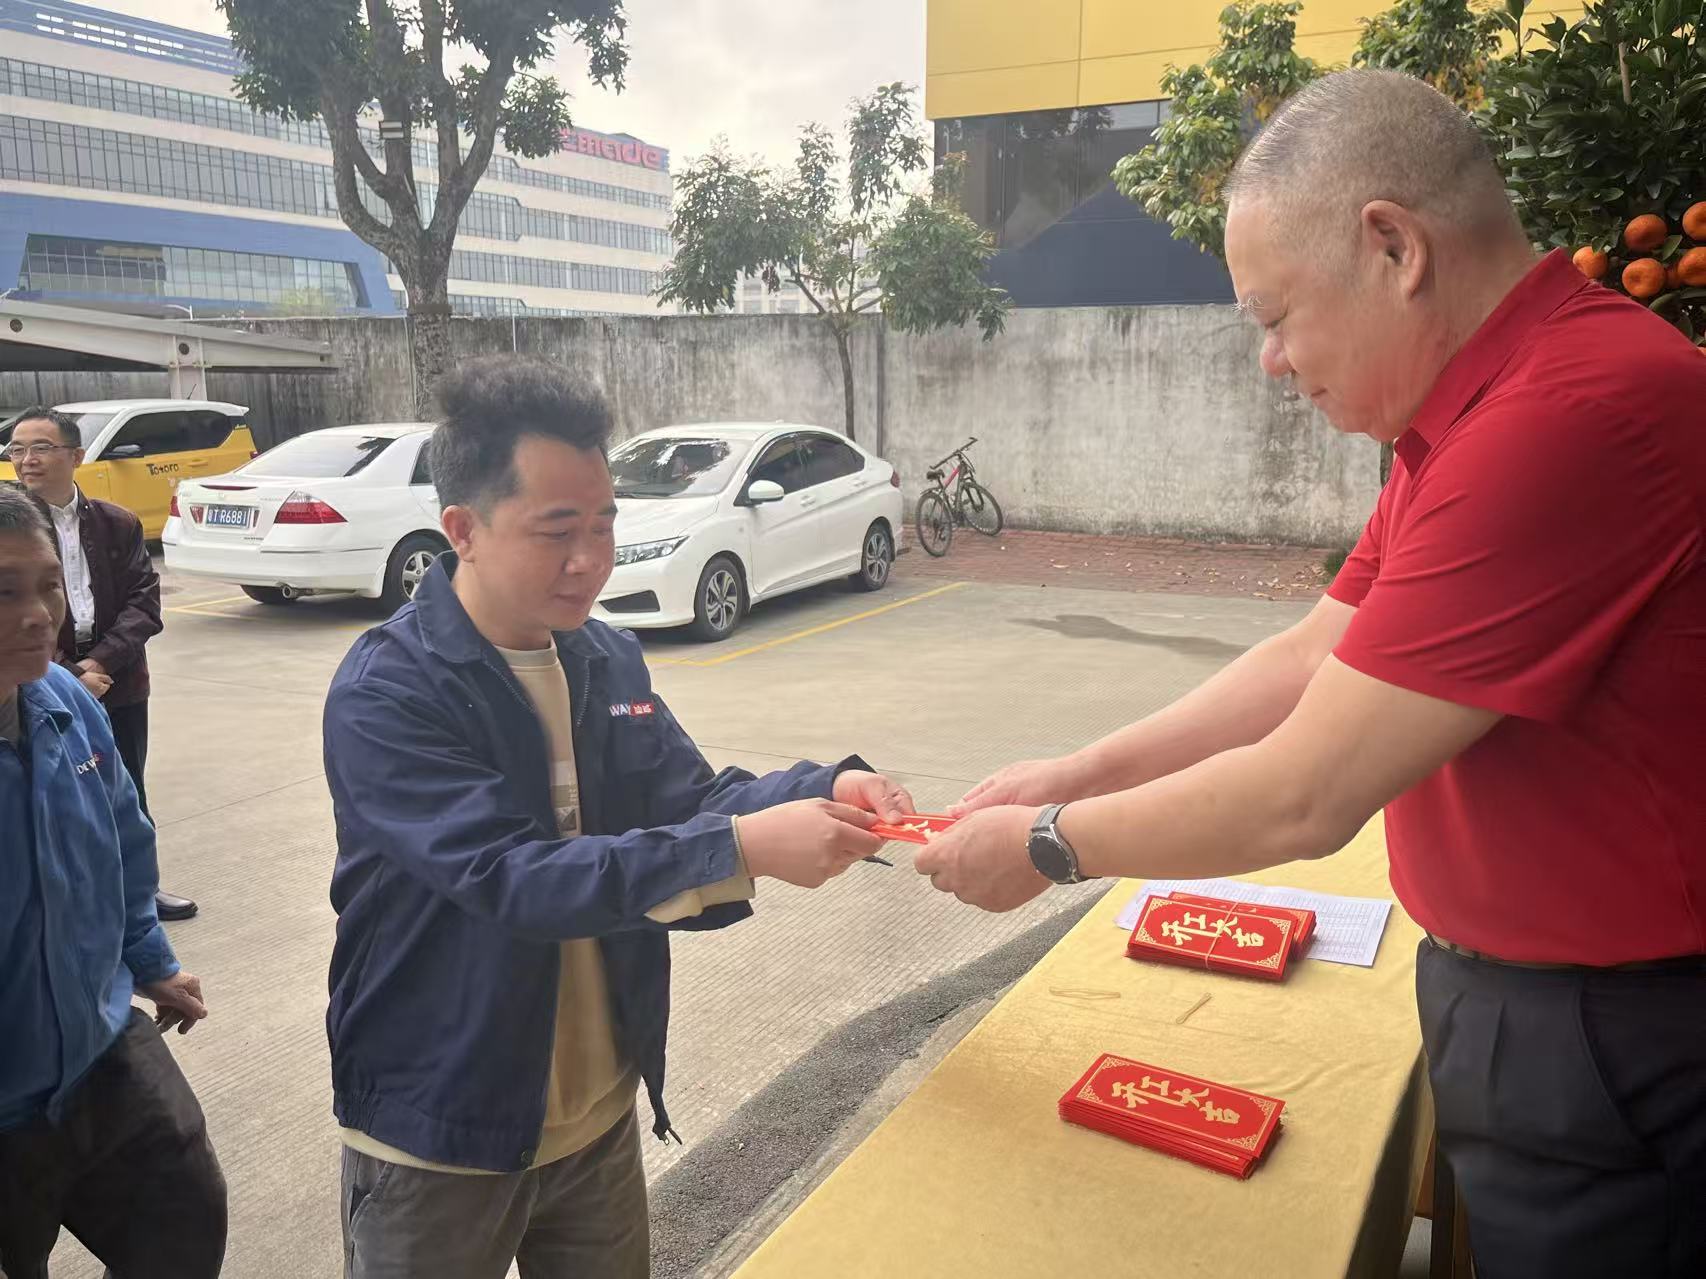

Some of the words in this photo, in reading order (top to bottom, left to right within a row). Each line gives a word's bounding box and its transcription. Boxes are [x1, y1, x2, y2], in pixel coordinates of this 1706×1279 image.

[1160, 911, 1265, 948] 开工大吉
[1111, 1075, 1241, 1125] 开工大吉
